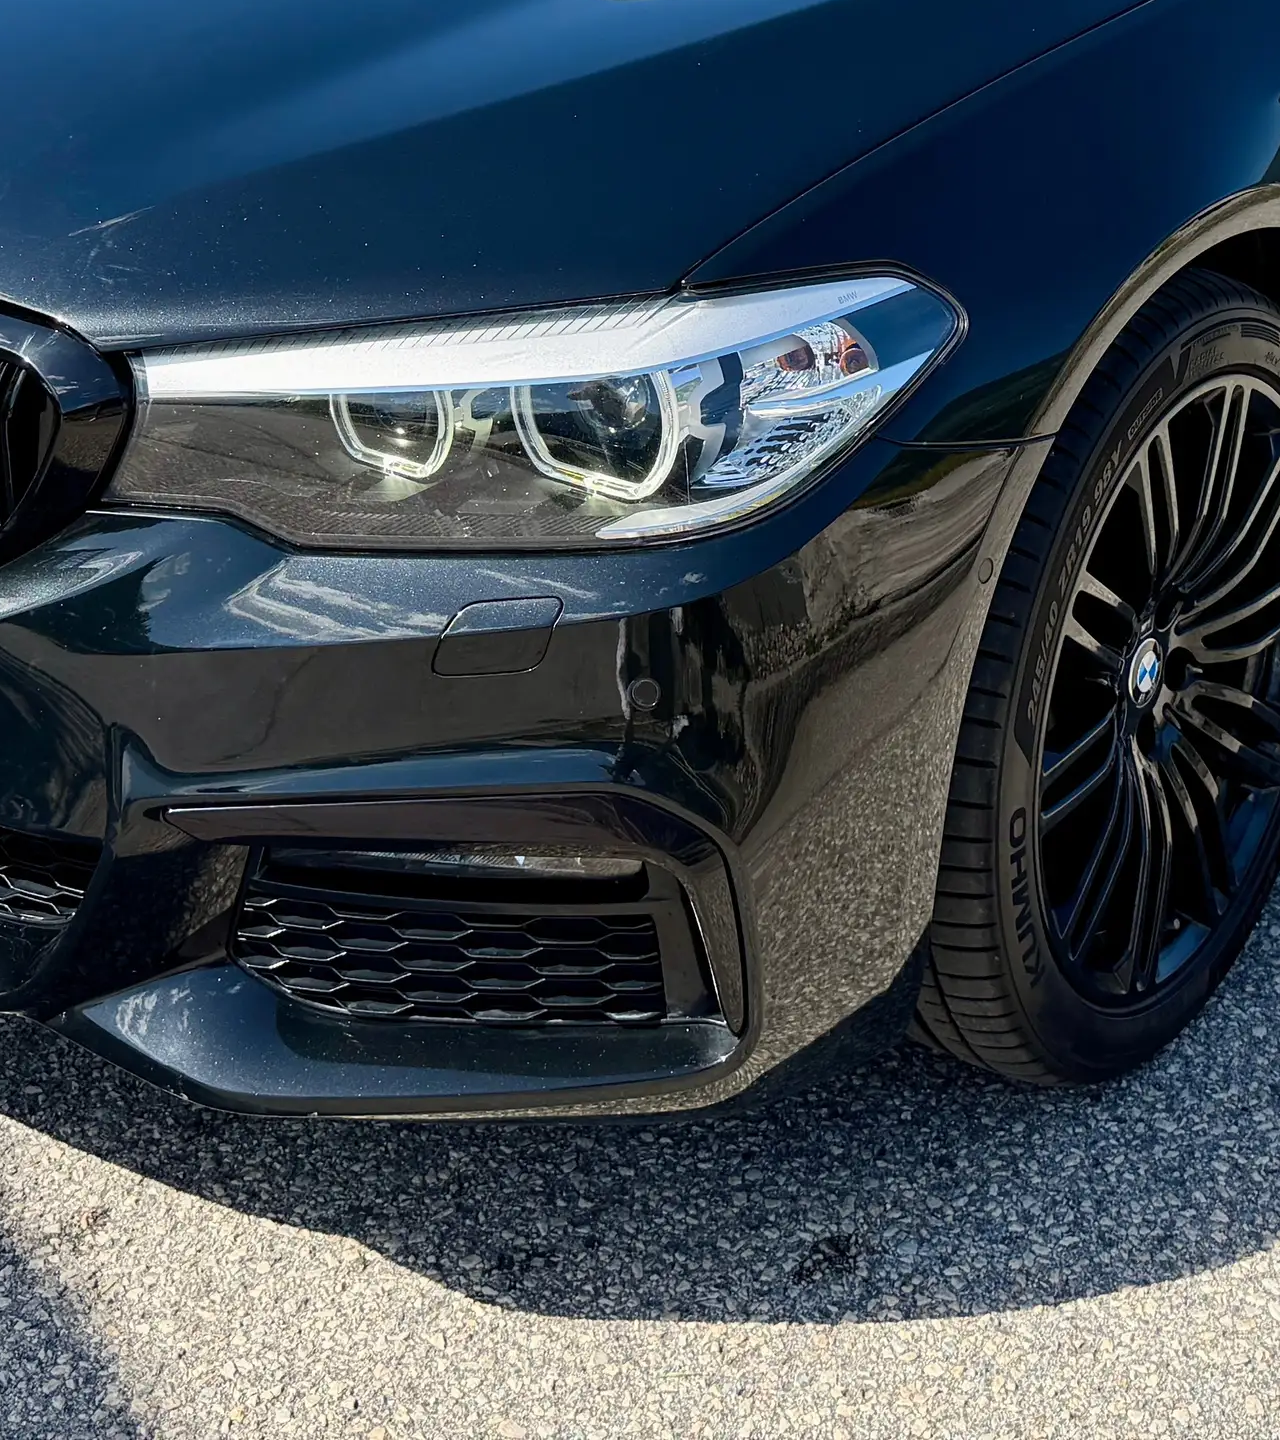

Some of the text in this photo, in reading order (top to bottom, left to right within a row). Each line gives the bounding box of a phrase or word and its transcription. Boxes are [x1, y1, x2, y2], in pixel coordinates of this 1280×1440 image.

[837, 289, 858, 305] BMW
[1026, 600, 1059, 722] 245/40
[1058, 504, 1092, 591] ZR19
[1009, 806, 1046, 989] KUMHO
